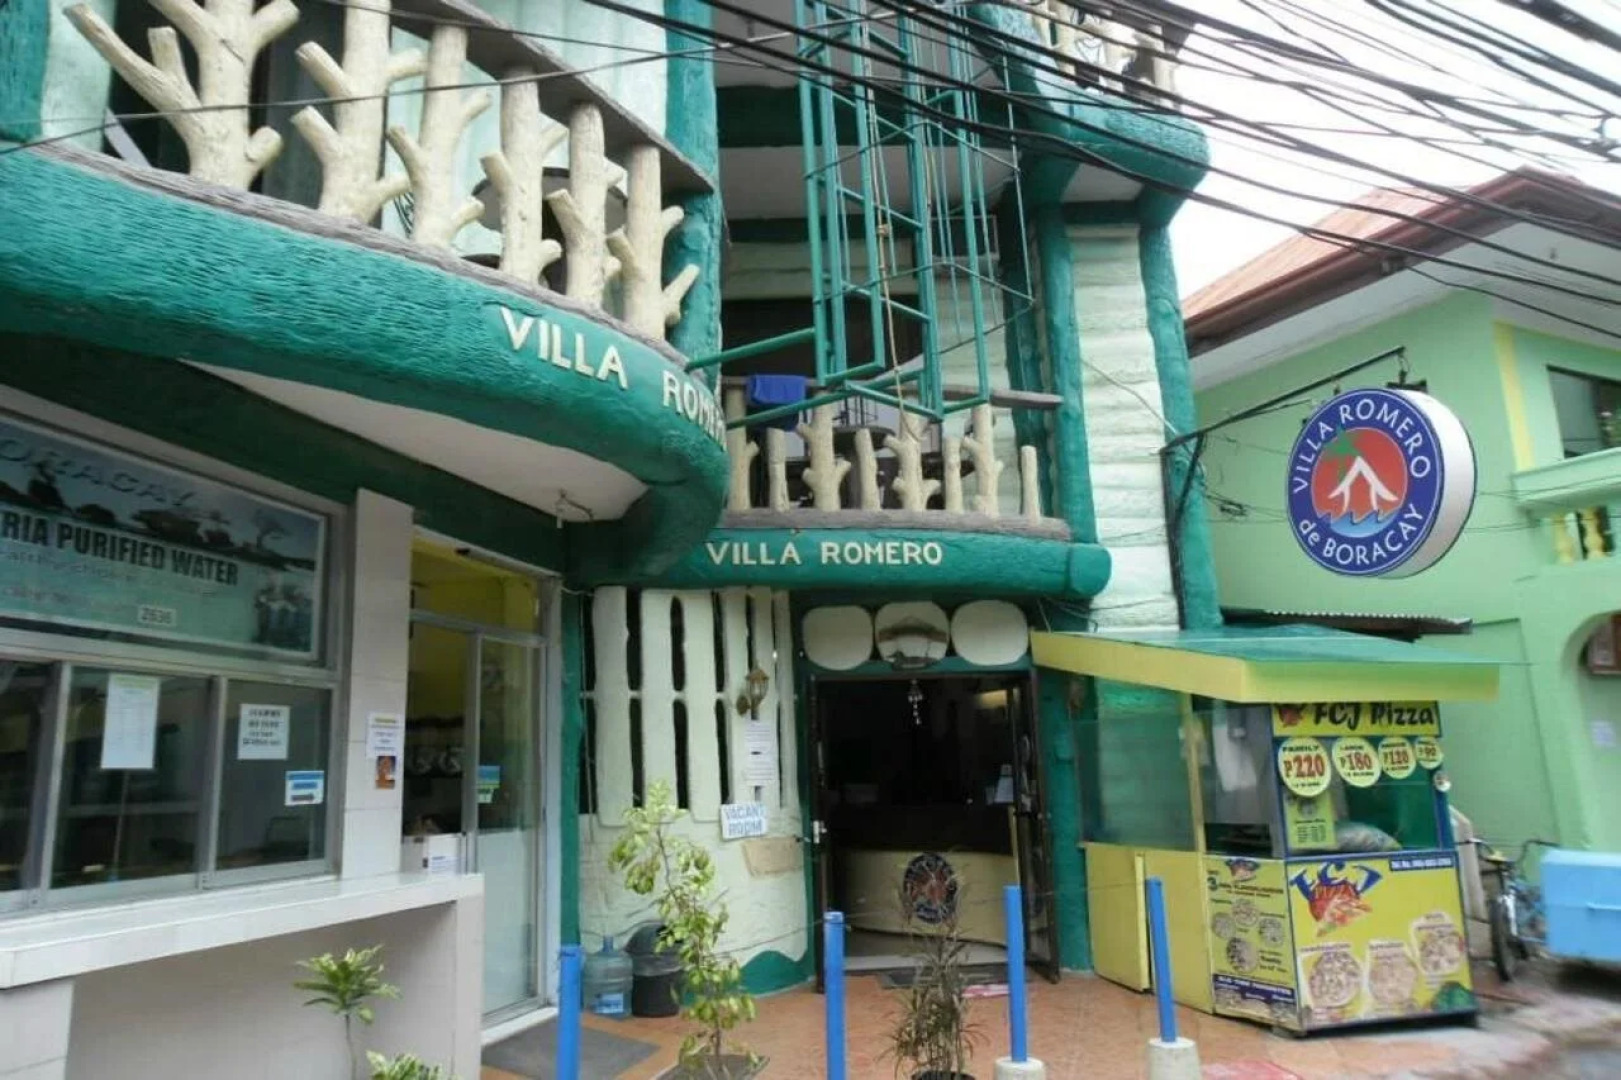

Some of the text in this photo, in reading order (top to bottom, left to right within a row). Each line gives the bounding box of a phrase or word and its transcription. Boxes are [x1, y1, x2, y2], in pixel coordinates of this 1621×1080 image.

[500, 306, 629, 389] VILLA
[1293, 399, 1431, 494] VILLA ROMERO
[56, 521, 166, 570] PURIFIED
[171, 549, 238, 586] WATER
[706, 541, 942, 565] VILLA ROMERO
[1300, 504, 1423, 566] de BORACAY
[1314, 702, 1434, 731] FCJ Pizza
